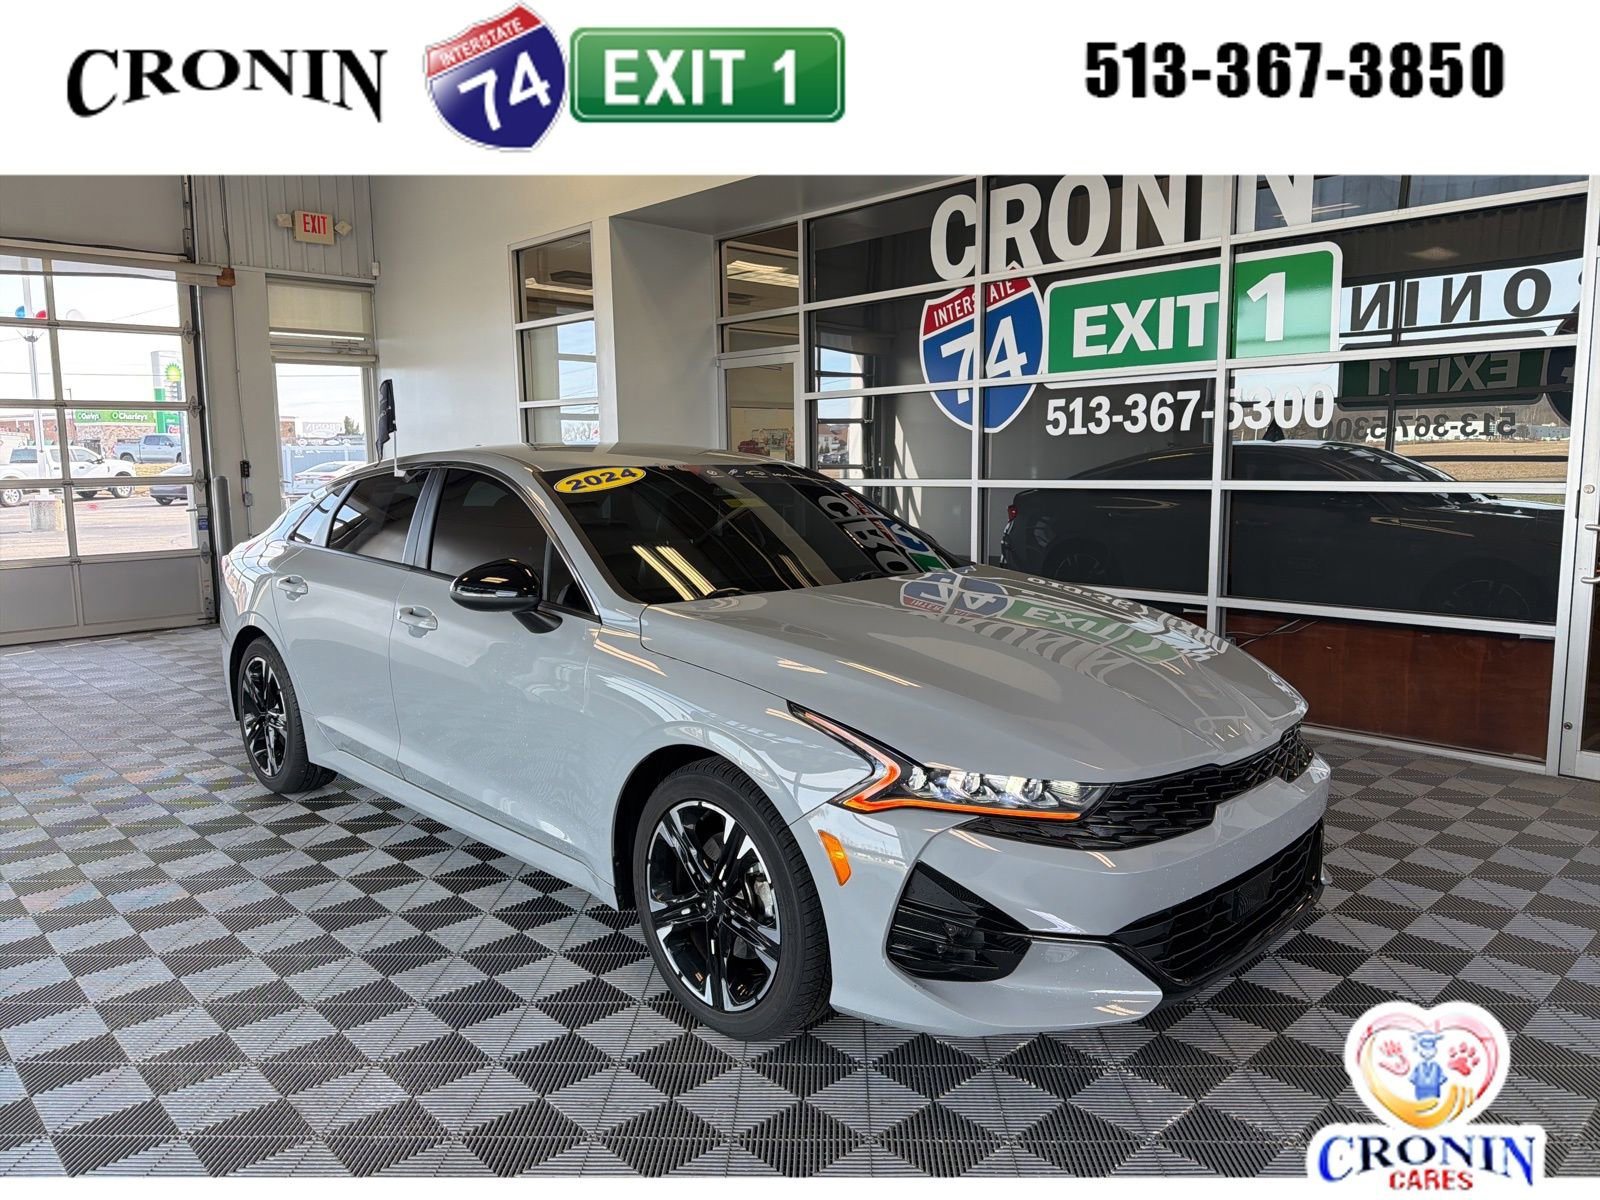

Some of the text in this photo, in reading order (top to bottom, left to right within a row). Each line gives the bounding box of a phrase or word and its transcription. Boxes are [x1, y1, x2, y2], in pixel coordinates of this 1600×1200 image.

[303, 213, 327, 235] EXIT
[930, 175, 1313, 281] CRONIN
[934, 281, 1015, 327] INTERATE
[1073, 272, 1286, 358] EXIT 1
[940, 316, 1028, 404] 74
[566, 469, 637, 491] 2024
